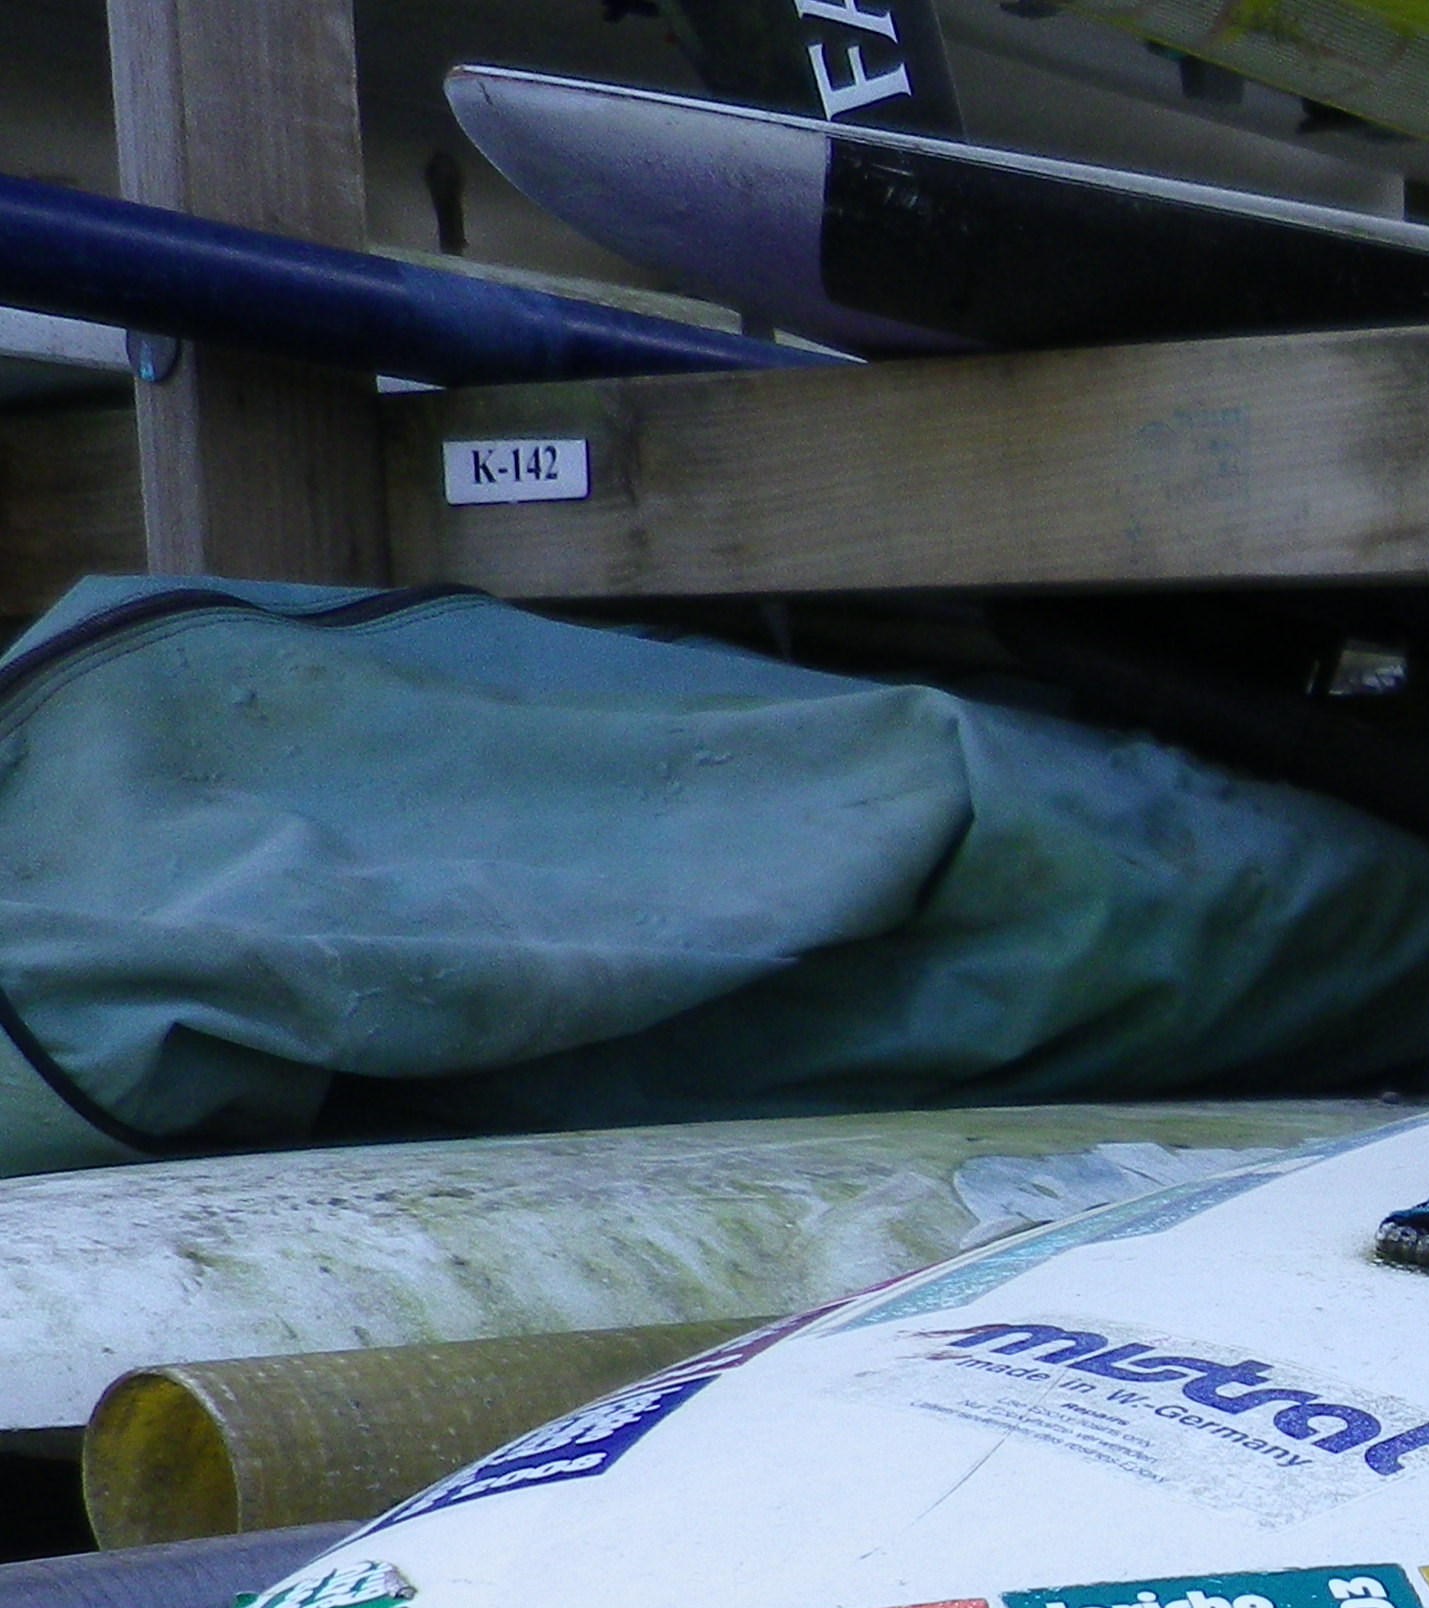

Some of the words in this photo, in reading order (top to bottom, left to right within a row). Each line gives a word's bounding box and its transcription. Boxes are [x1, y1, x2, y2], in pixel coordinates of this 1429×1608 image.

[472, 446, 559, 484] K-142
[957, 1356, 1052, 1384] made
[1059, 1377, 1097, 1393] in
[1106, 1387, 1316, 1470] W.-Germany
[1060, 1402, 1130, 1427] Repairs
